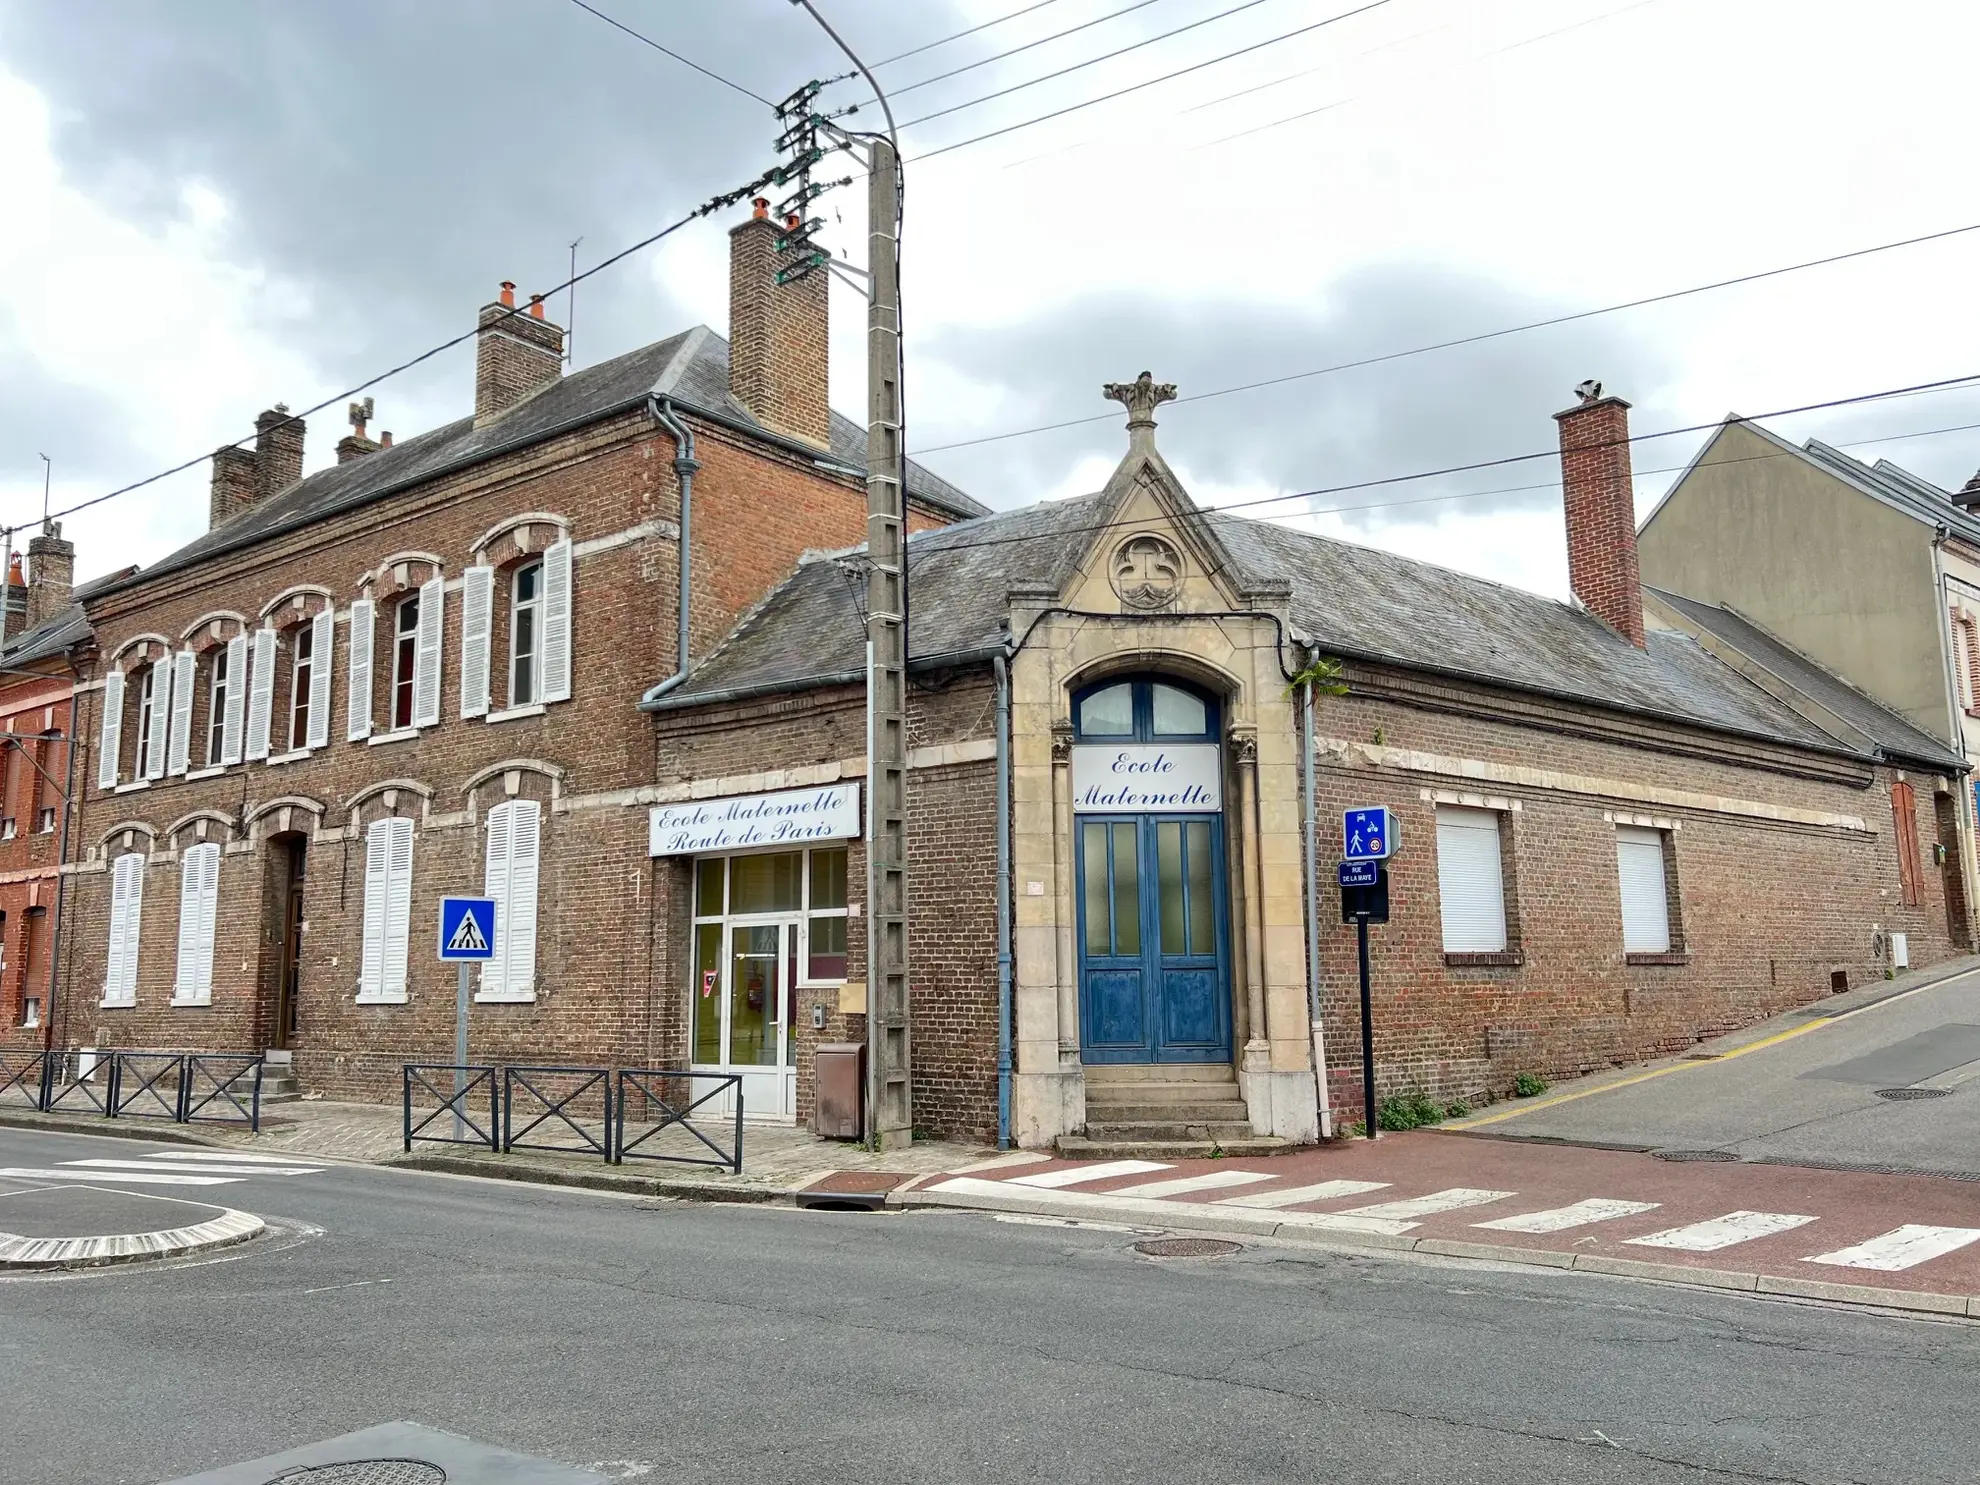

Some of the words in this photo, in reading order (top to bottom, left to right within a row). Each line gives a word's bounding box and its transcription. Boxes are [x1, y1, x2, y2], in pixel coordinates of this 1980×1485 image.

[1111, 752, 1177, 773] Ecole
[1074, 784, 1215, 805] Maternelle
[658, 806, 711, 829] Ecole
[717, 791, 847, 822] Maternelle
[667, 828, 733, 851] Route
[738, 825, 766, 844] de
[771, 819, 837, 840] Paris
